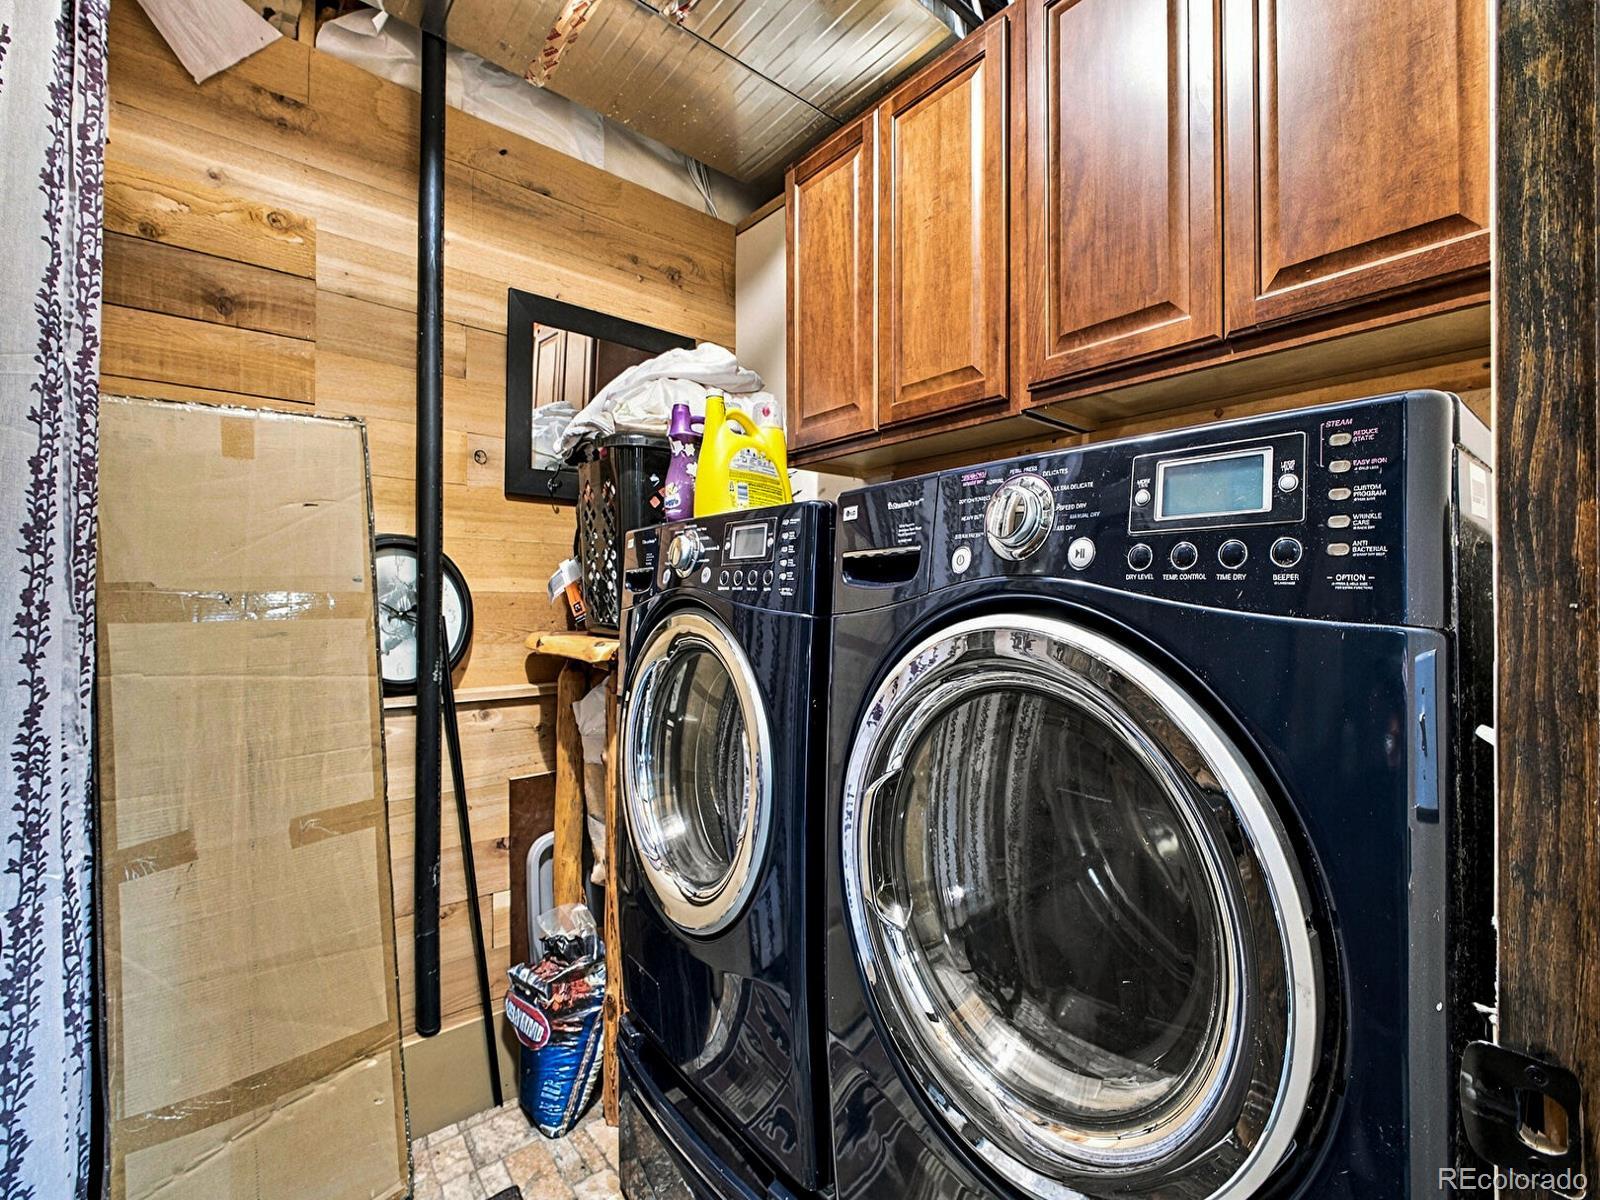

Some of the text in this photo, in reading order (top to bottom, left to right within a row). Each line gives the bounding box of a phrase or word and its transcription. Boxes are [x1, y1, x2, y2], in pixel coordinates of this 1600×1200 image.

[1325, 418, 1353, 428] STEAM
[1353, 427, 1379, 436] REDUCE
[1042, 467, 1069, 477] DELICATES
[1070, 481, 1094, 490] DELICATE
[1353, 483, 1382, 491] CUSTOM
[1353, 489, 1387, 497] PROGRAM
[1075, 502, 1087, 510] DRY
[1352, 512, 1383, 520] WRINKLE
[1352, 545, 1388, 553] BACTERIAL
[1125, 573, 1138, 581] DRY
[1216, 573, 1247, 581] TIME DRY
[1272, 573, 1300, 581] BEEPER
[1335, 573, 1366, 581] OPTION
